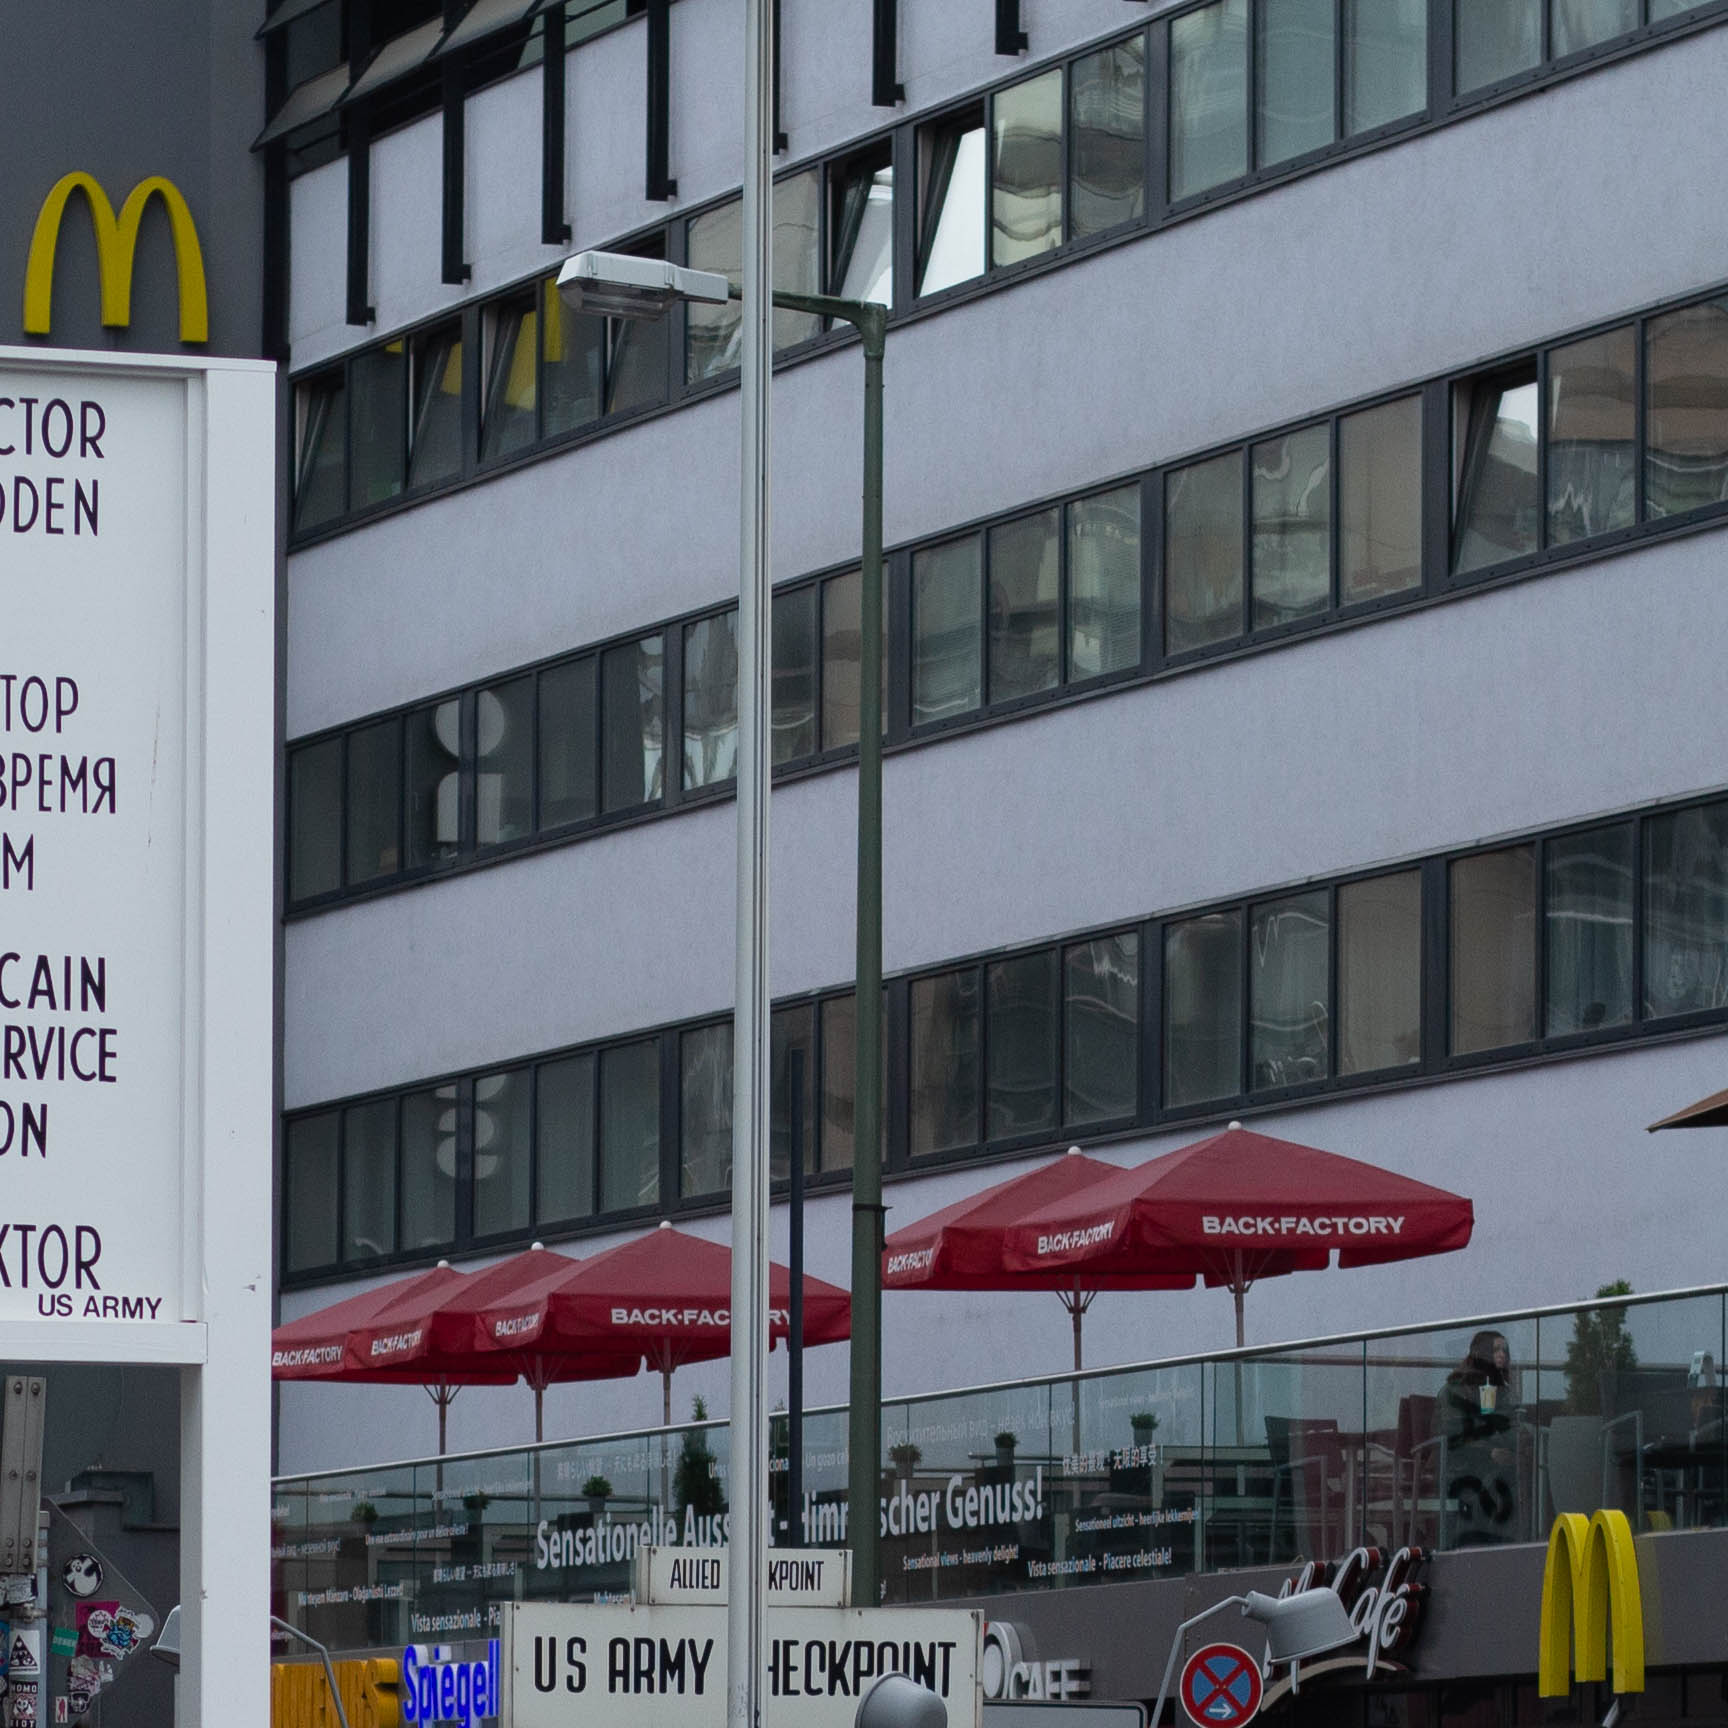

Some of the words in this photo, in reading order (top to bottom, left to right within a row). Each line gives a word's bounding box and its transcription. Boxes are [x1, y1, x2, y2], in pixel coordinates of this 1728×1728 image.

[38, 1293, 73, 1317] US
[83, 1295, 162, 1320] ARMY
[536, 1504, 678, 1570] Sensationelle
[945, 1465, 1043, 1530] Genuss!
[941, 1550, 958, 1567] views
[1027, 1557, 1046, 1578] Vista
[1047, 1553, 1096, 1576] sensazionale
[1103, 1550, 1131, 1571] Piacere
[670, 1559, 721, 1591] ALLIED
[768, 1560, 825, 1592] KPOINT
[411, 1612, 431, 1633] Vista
[432, 1607, 481, 1632] sensazionale
[1263, 1546, 1411, 1695] Café
[608, 1636, 714, 1696] ARMY
[768, 1639, 957, 1698] HECKPOINT
